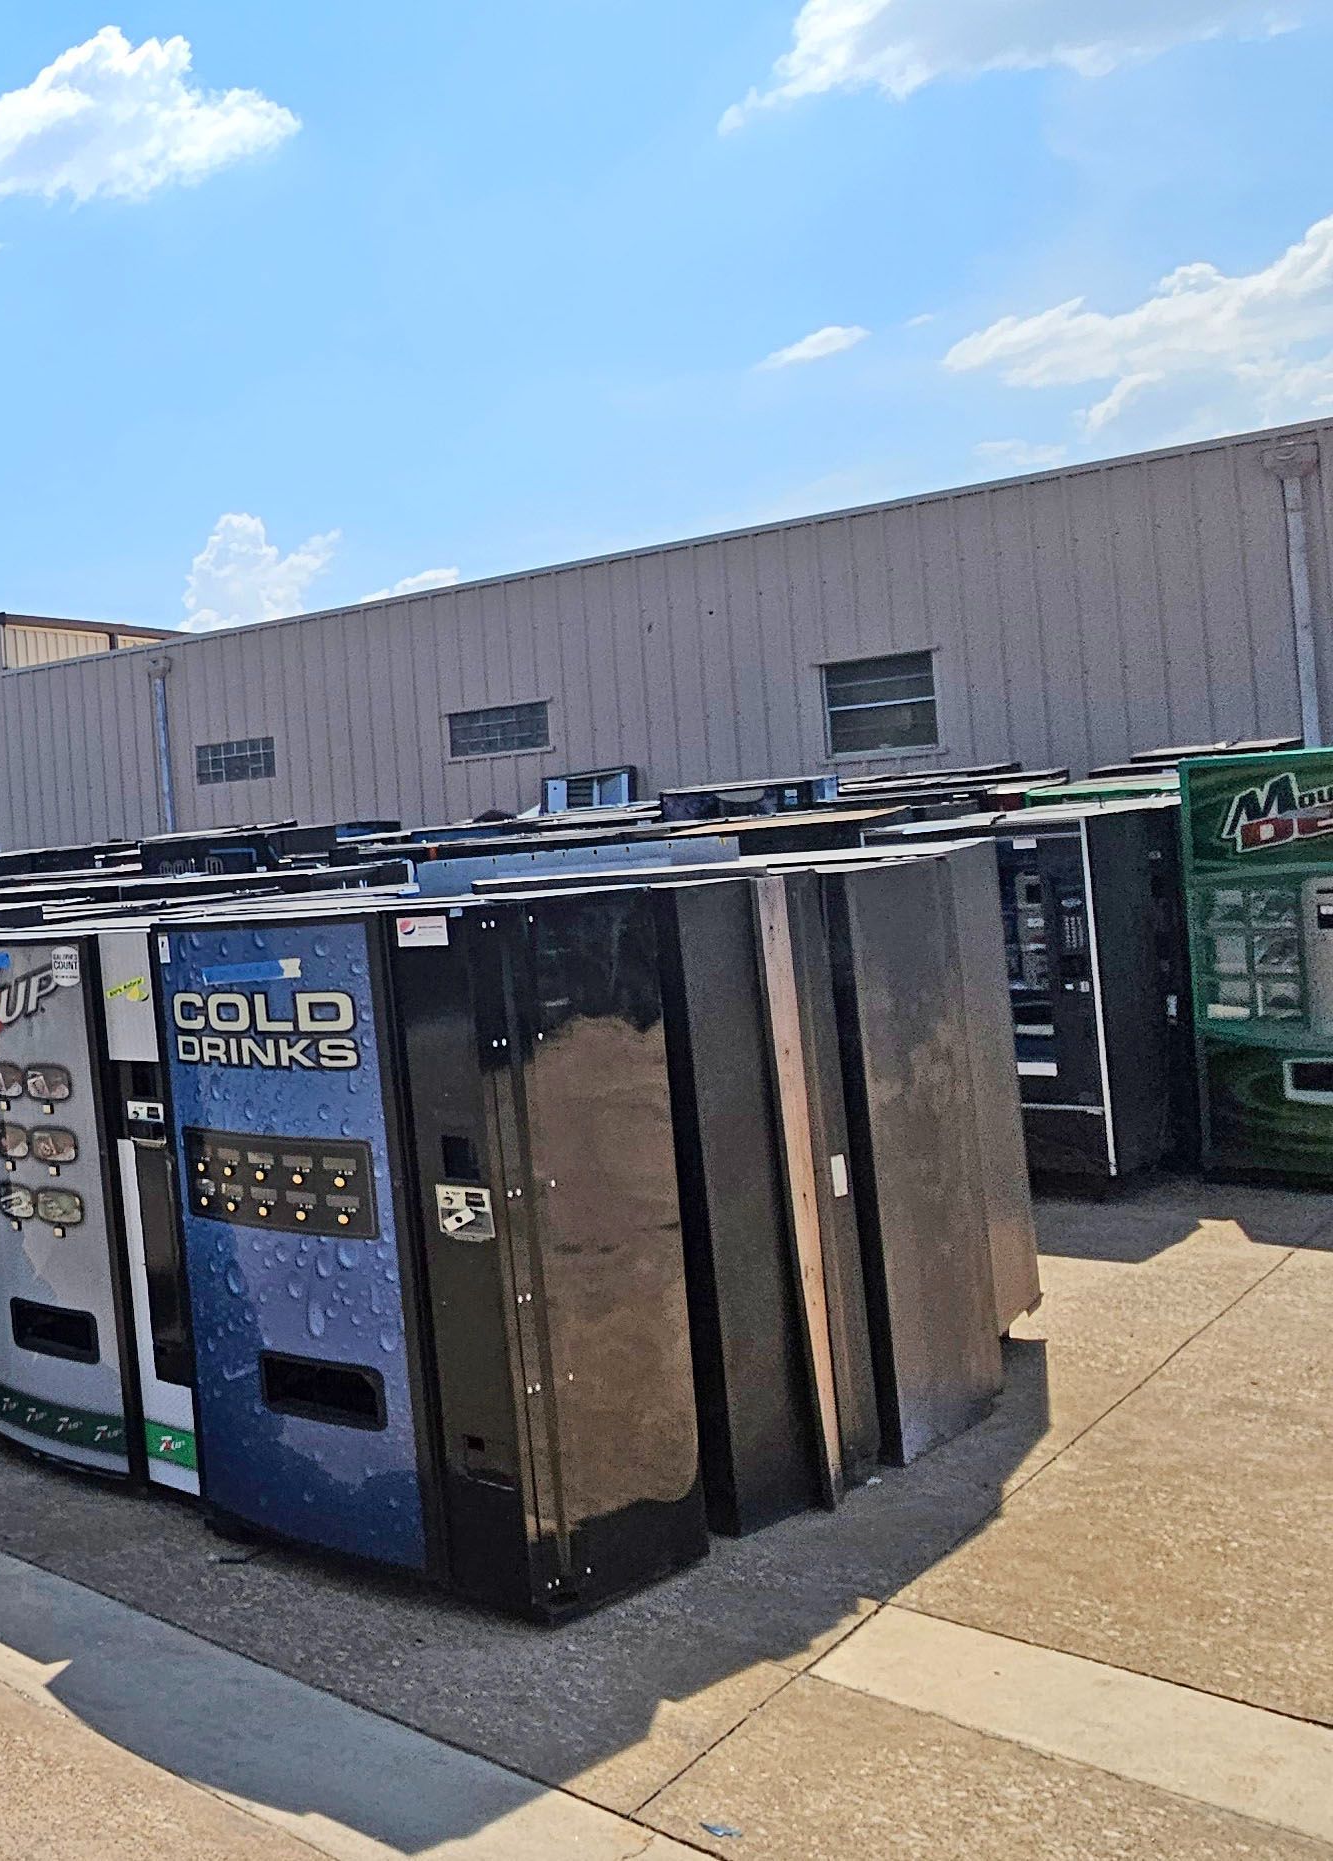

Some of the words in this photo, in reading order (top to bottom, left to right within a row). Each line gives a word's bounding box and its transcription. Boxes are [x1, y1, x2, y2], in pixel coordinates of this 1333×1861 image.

[54, 960, 78, 970] COUNT
[173, 991, 354, 1032] COLD
[177, 1034, 358, 1068] DRINKS
